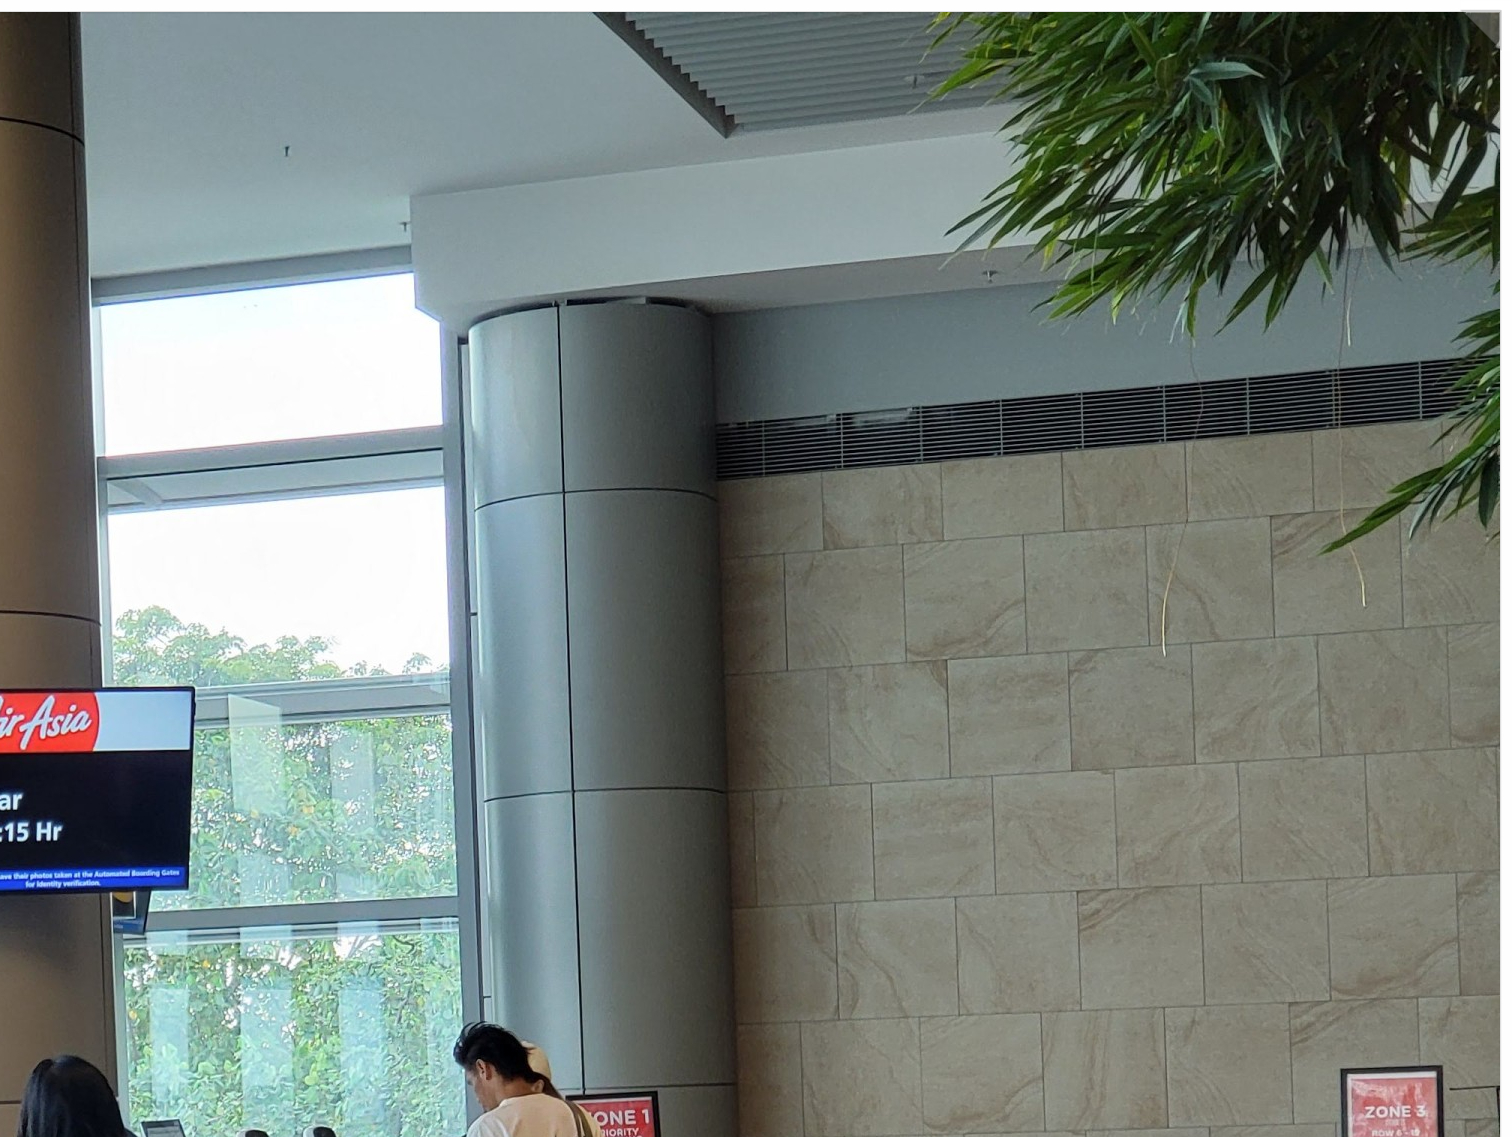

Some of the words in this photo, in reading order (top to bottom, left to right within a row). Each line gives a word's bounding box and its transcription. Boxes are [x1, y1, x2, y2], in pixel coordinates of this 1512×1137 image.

[36, 822, 63, 842] Hr
[30, 872, 52, 880] photos
[590, 1109, 636, 1126] ONE
[642, 1108, 650, 1124] 1
[1364, 1105, 1411, 1118] ZONE
[1415, 1104, 1427, 1117] 3
[601, 1127, 640, 1137] RIORITY
